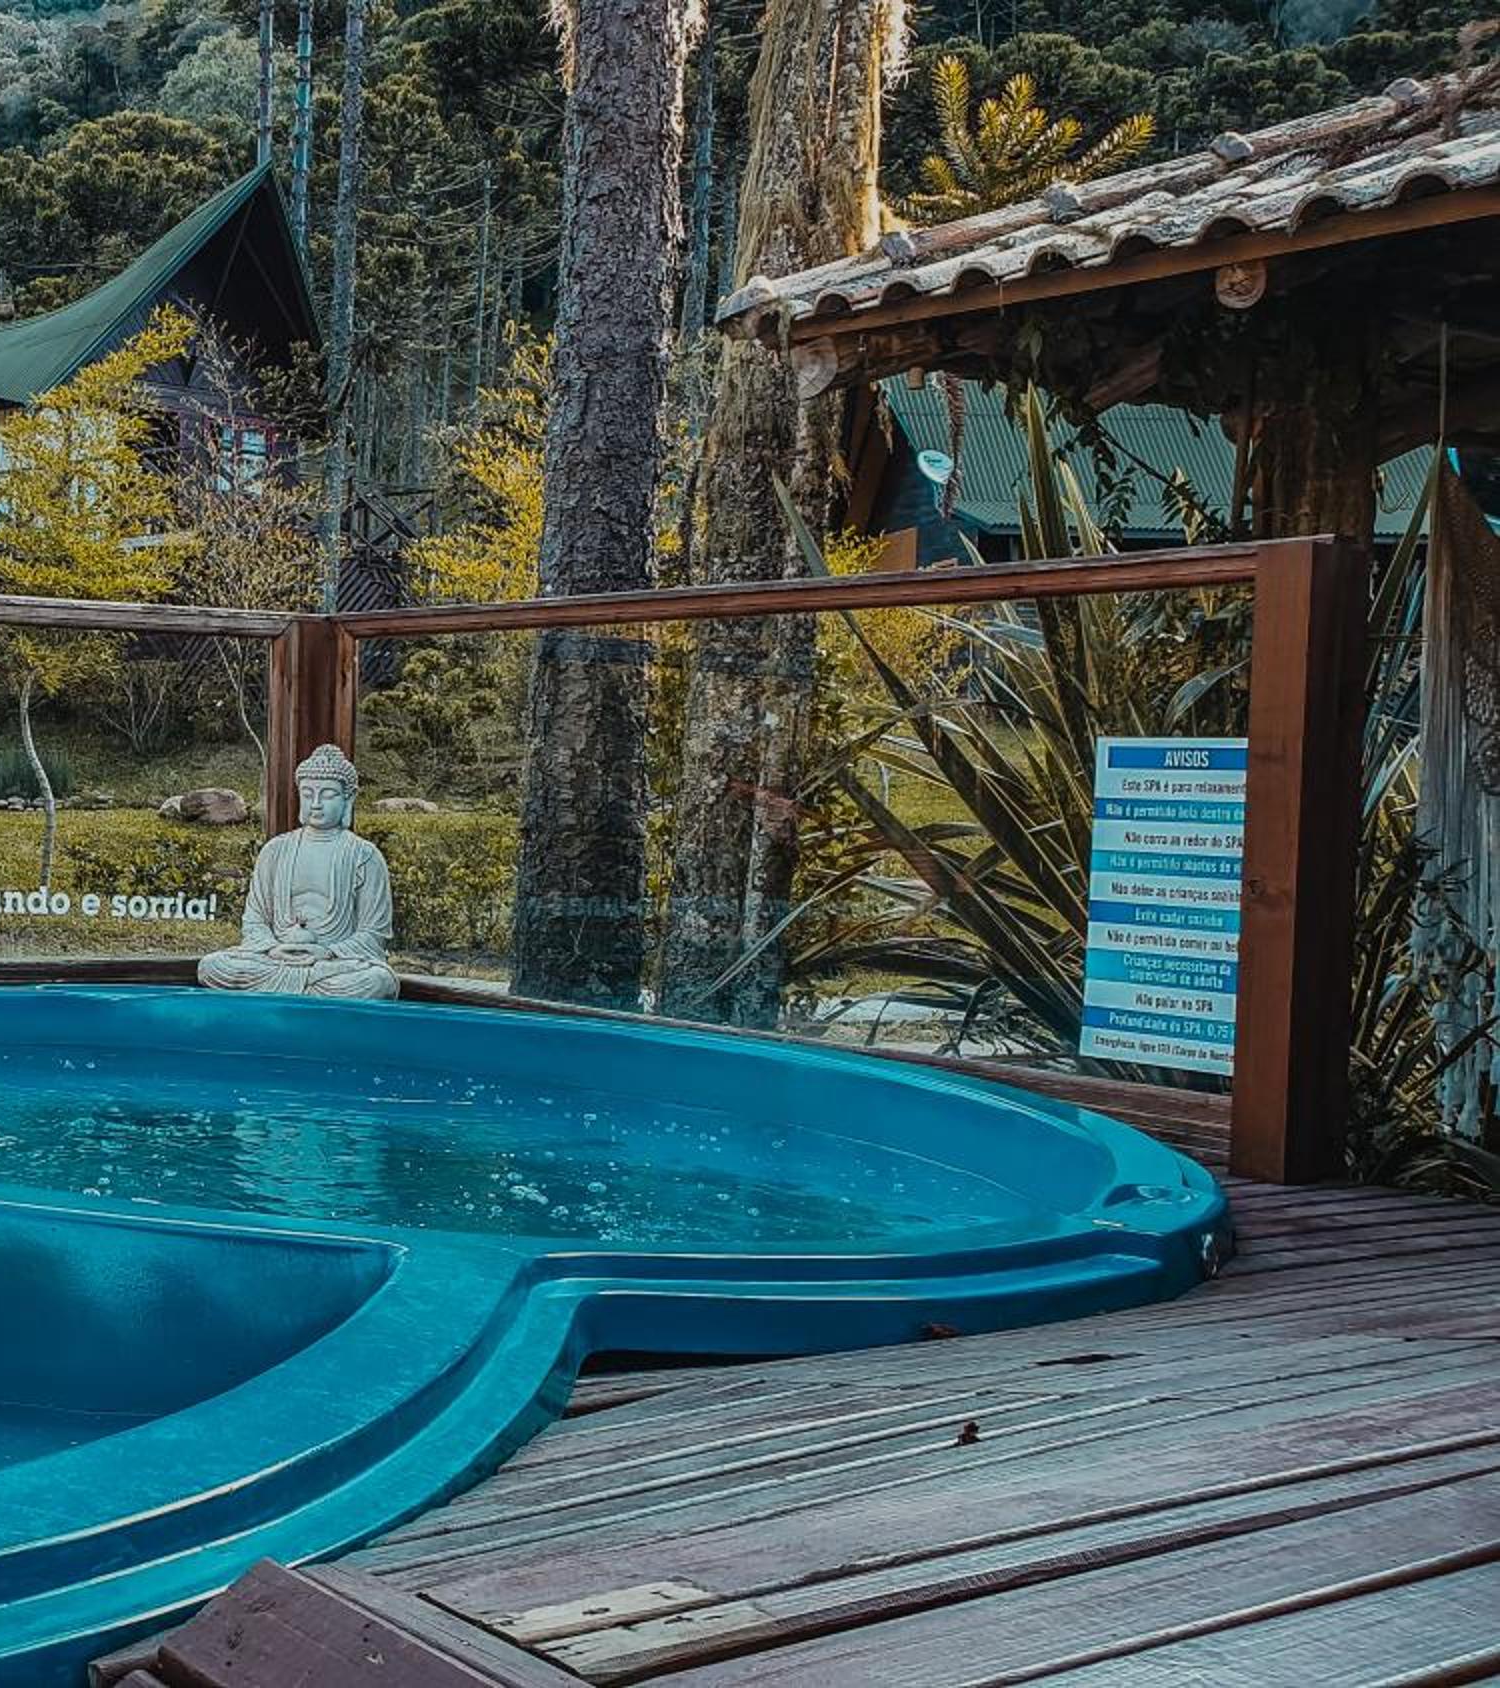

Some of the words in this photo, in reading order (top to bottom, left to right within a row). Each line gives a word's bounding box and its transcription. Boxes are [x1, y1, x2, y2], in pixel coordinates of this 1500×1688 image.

[1164, 751, 1210, 767] AVISOS
[1122, 779, 1141, 792] Este
[1144, 780, 1161, 792] SPA
[1171, 783, 1192, 795] para
[1124, 832, 1142, 844] Não
[1144, 834, 1167, 846] corra
[1184, 834, 1209, 848] redor
[1111, 882, 1128, 894] Não
[81, 897, 100, 915] e
[112, 891, 218, 921] sorria!
[1107, 929, 1124, 943] Não
[1123, 953, 1163, 970] Crianças
[1195, 999, 1213, 1013] SPA
